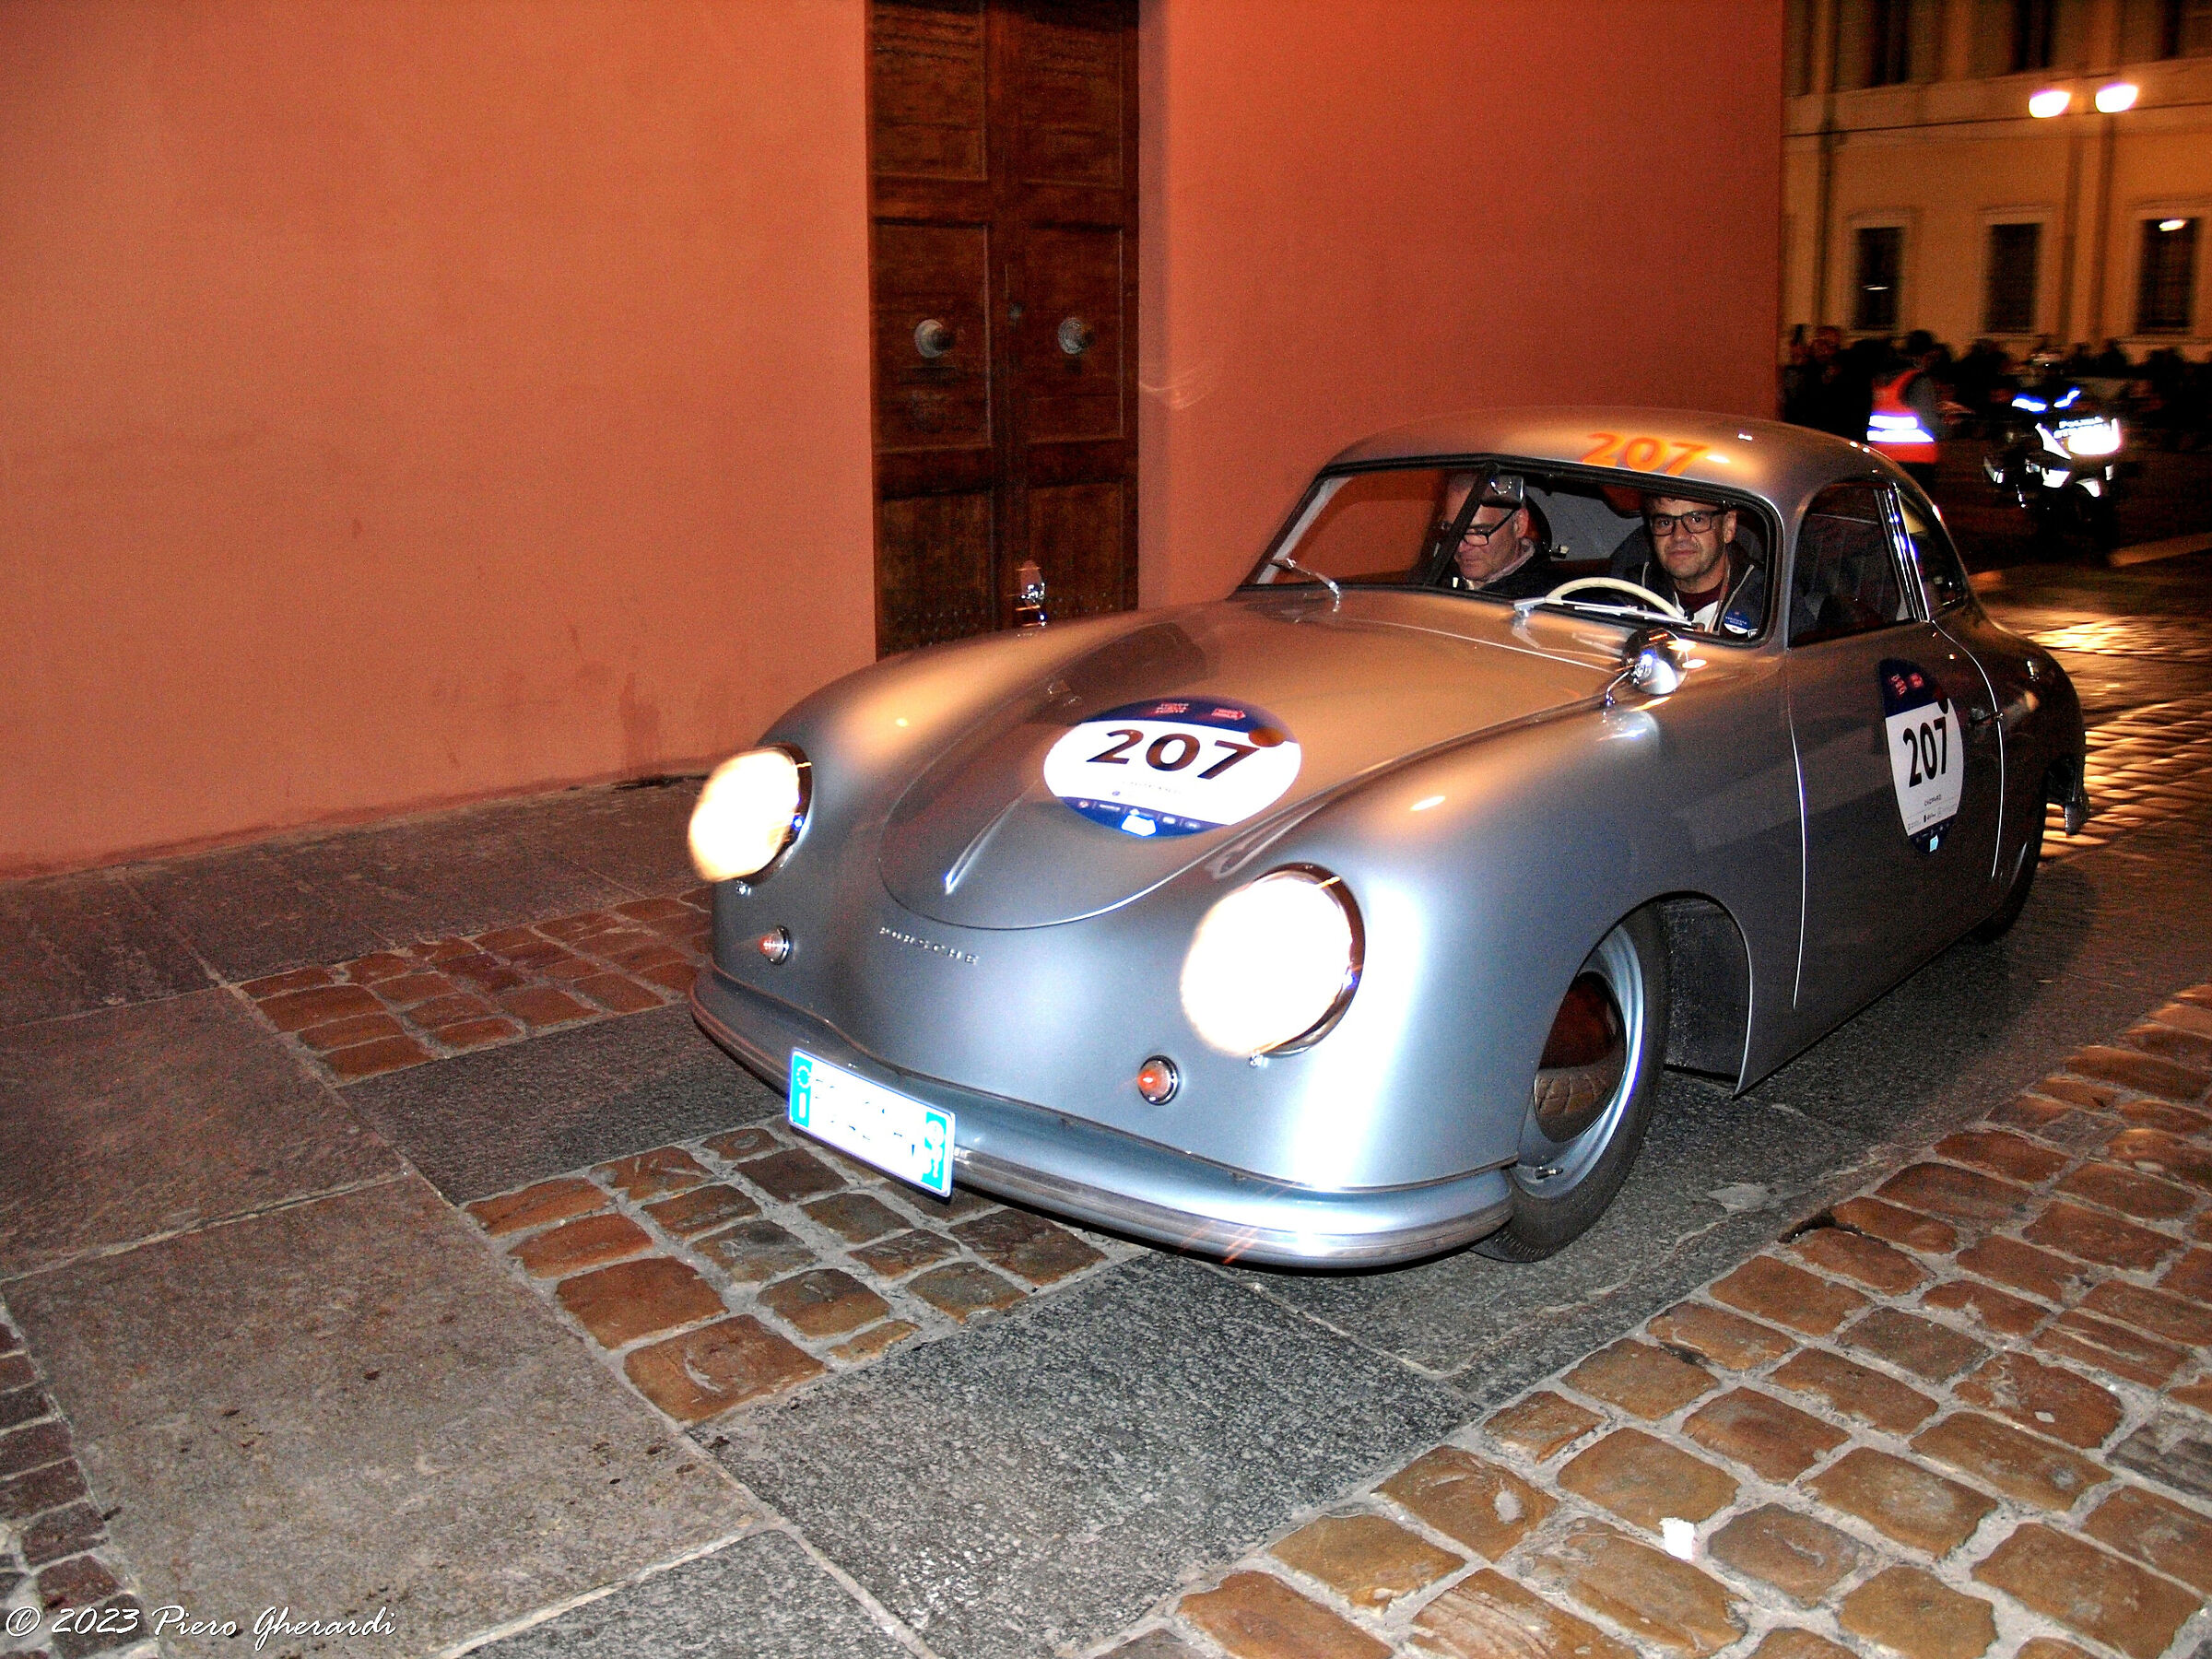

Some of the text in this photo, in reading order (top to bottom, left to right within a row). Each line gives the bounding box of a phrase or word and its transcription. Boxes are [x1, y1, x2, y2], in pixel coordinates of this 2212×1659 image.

[1580, 431, 1710, 477] 207
[1087, 728, 1260, 781] 207
[1902, 716, 1947, 788] 207
